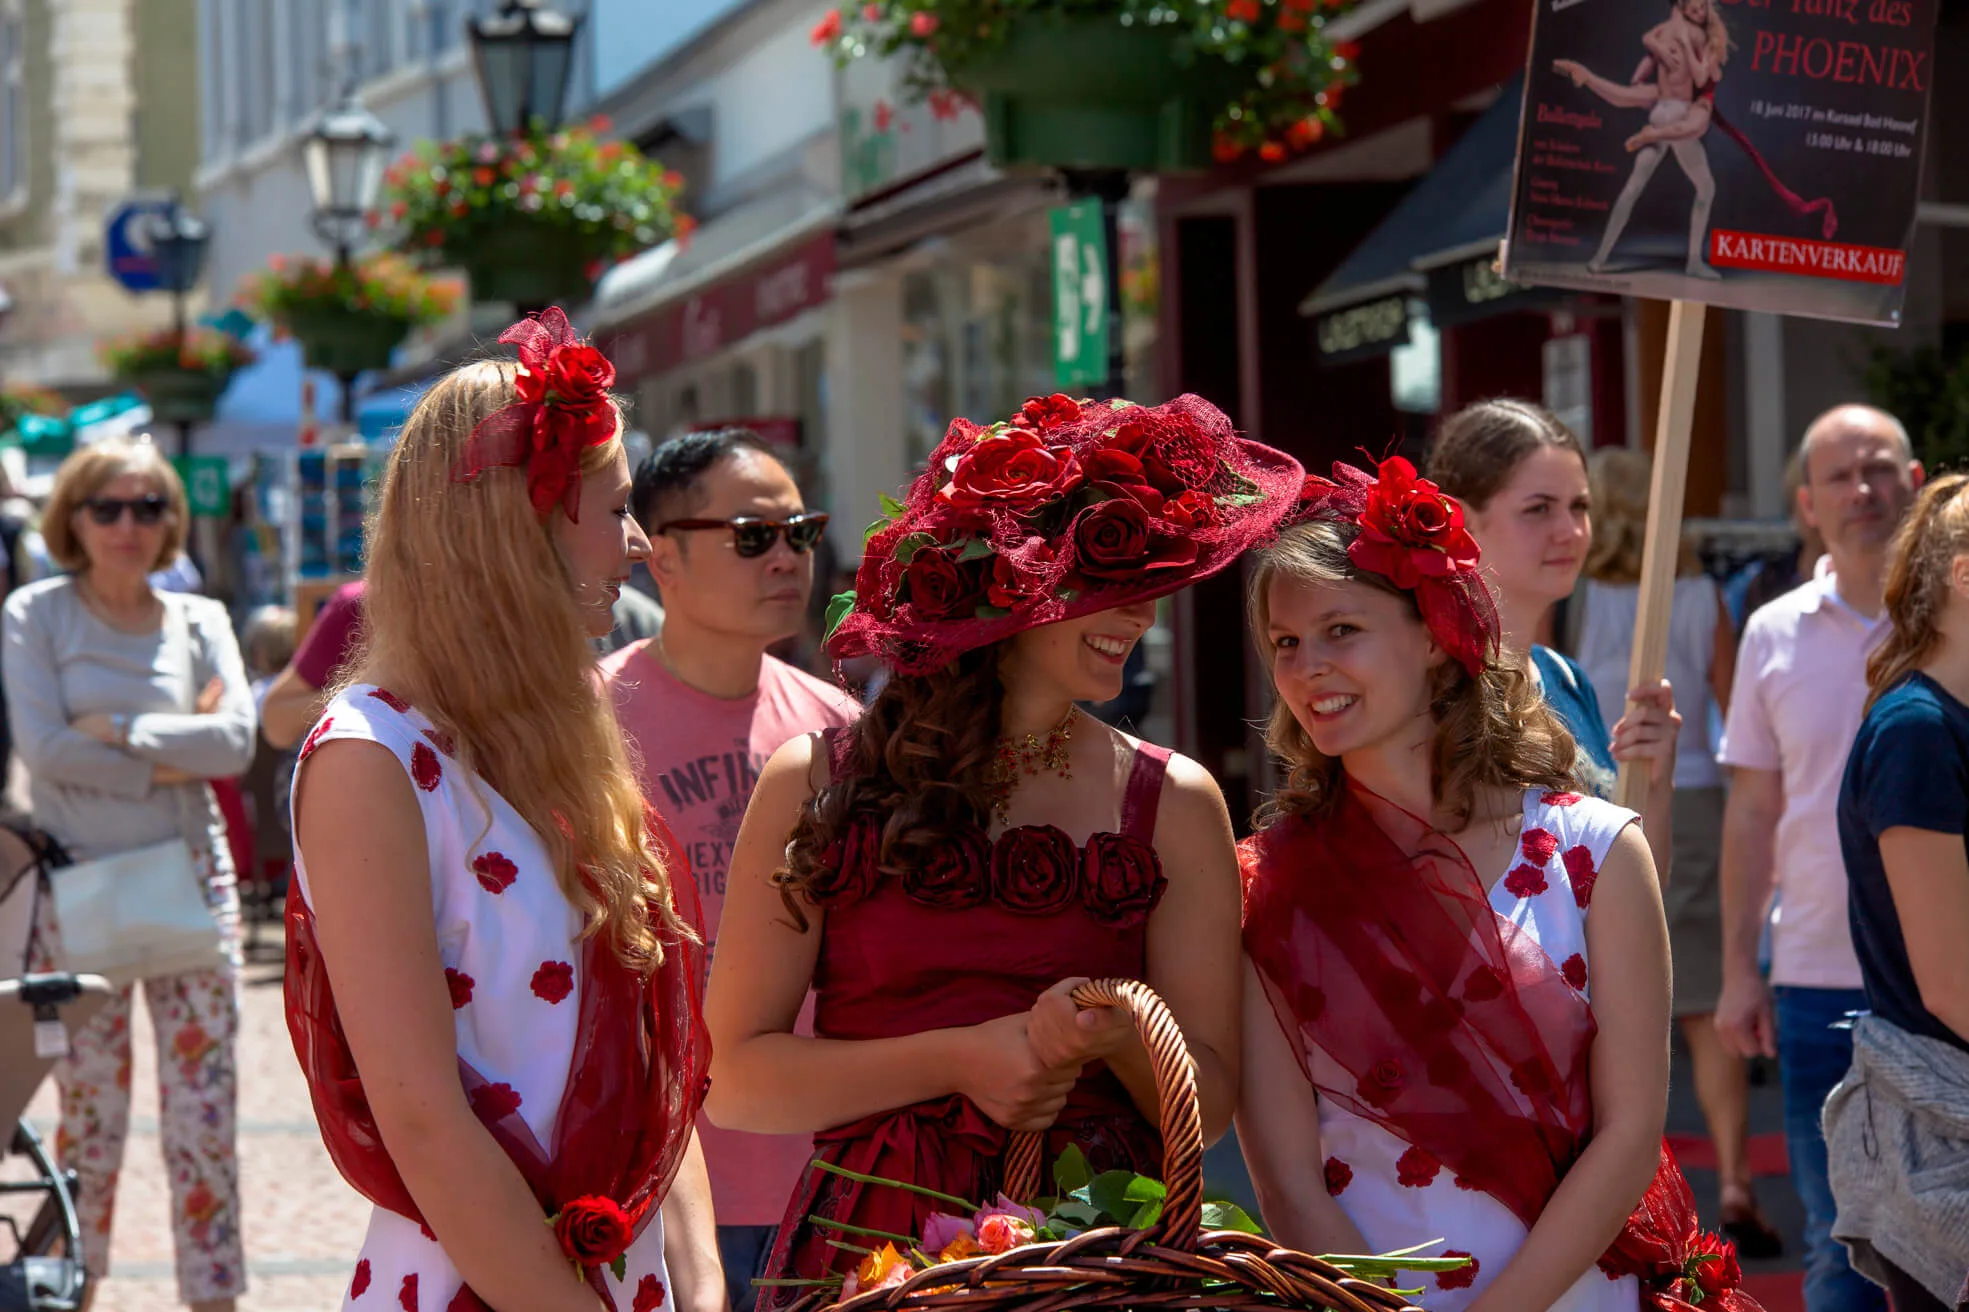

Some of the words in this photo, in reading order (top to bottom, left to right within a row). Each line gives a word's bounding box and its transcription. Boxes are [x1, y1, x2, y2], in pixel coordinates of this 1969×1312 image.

[1868, 0, 1912, 26] des
[1751, 30, 1926, 91] PHOENIX
[1785, 104, 1811, 119] 2017
[1717, 234, 1903, 277] KARTENVERKAUF
[659, 751, 770, 806] INFIN
